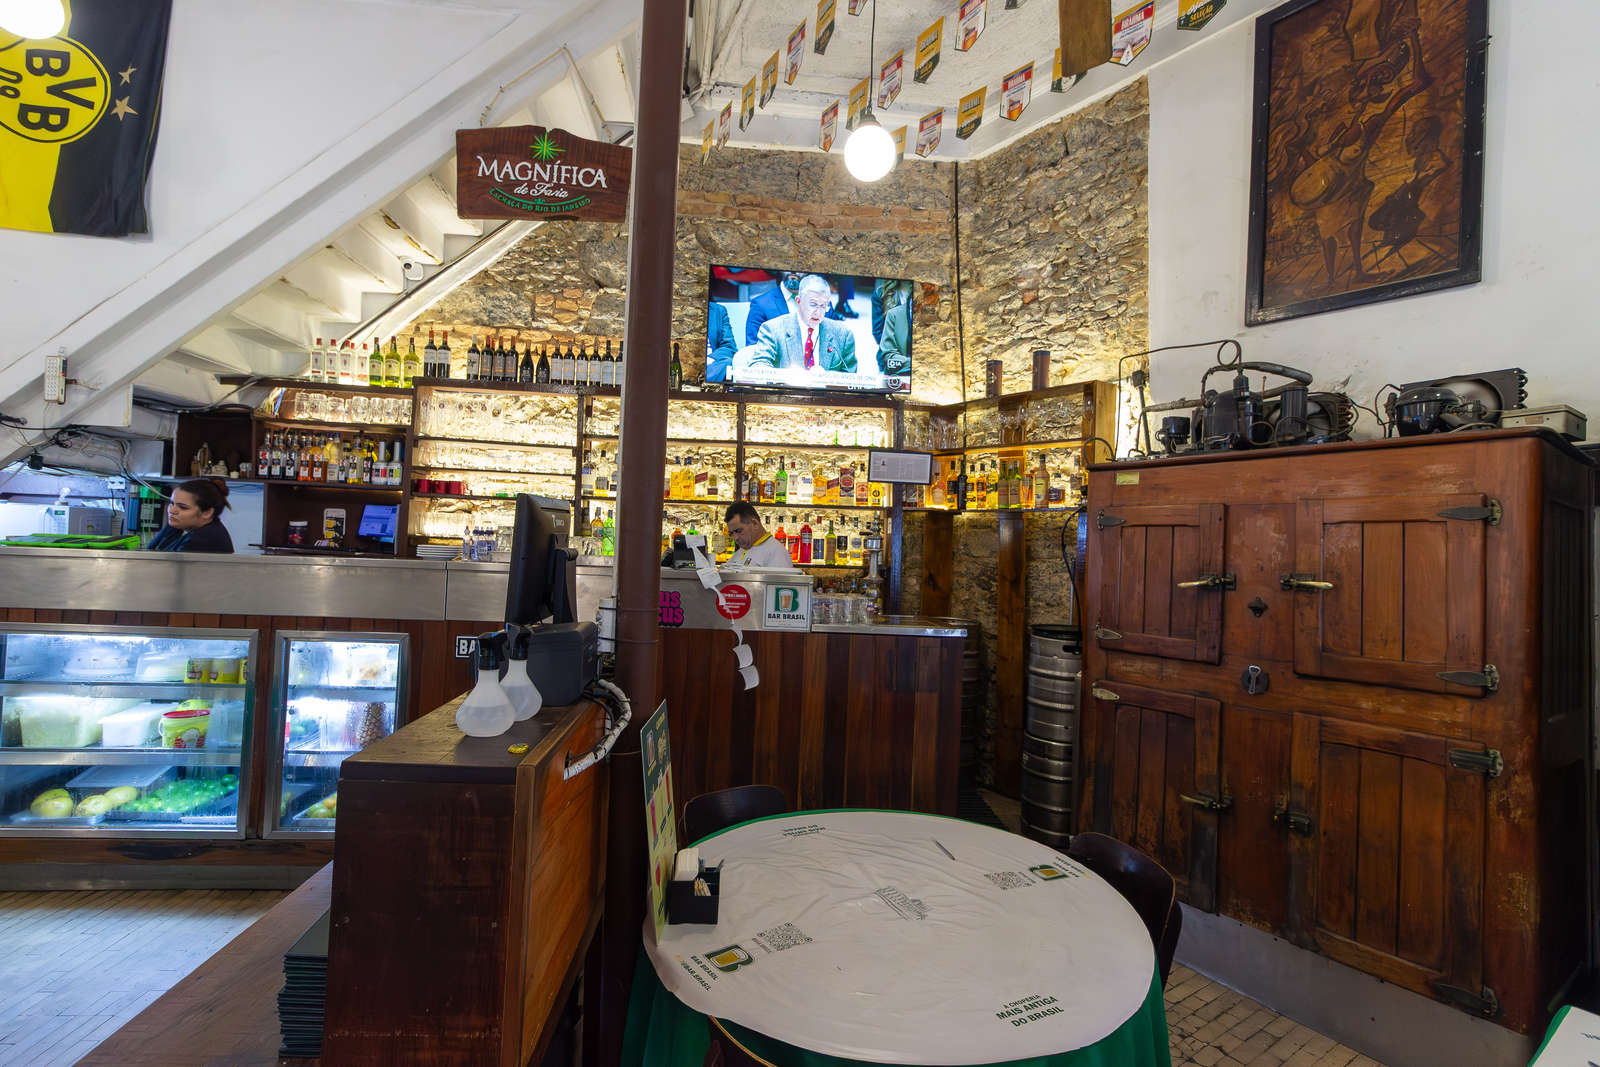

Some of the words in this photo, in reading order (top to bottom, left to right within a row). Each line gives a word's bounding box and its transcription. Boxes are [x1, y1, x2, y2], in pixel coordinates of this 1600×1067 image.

[17, 49, 97, 132] BVB
[476, 155, 608, 189] MAGNÍFICA
[514, 182, 529, 196] de
[530, 182, 569, 199] Faria
[535, 205, 549, 213] RIO
[782, 613, 806, 621] BRASIL
[995, 1007, 1024, 1020] MAIS
[1023, 996, 1059, 1012] ANTIGA
[1011, 1017, 1028, 1027] DO
[1027, 1006, 1065, 1022] BRASIL
